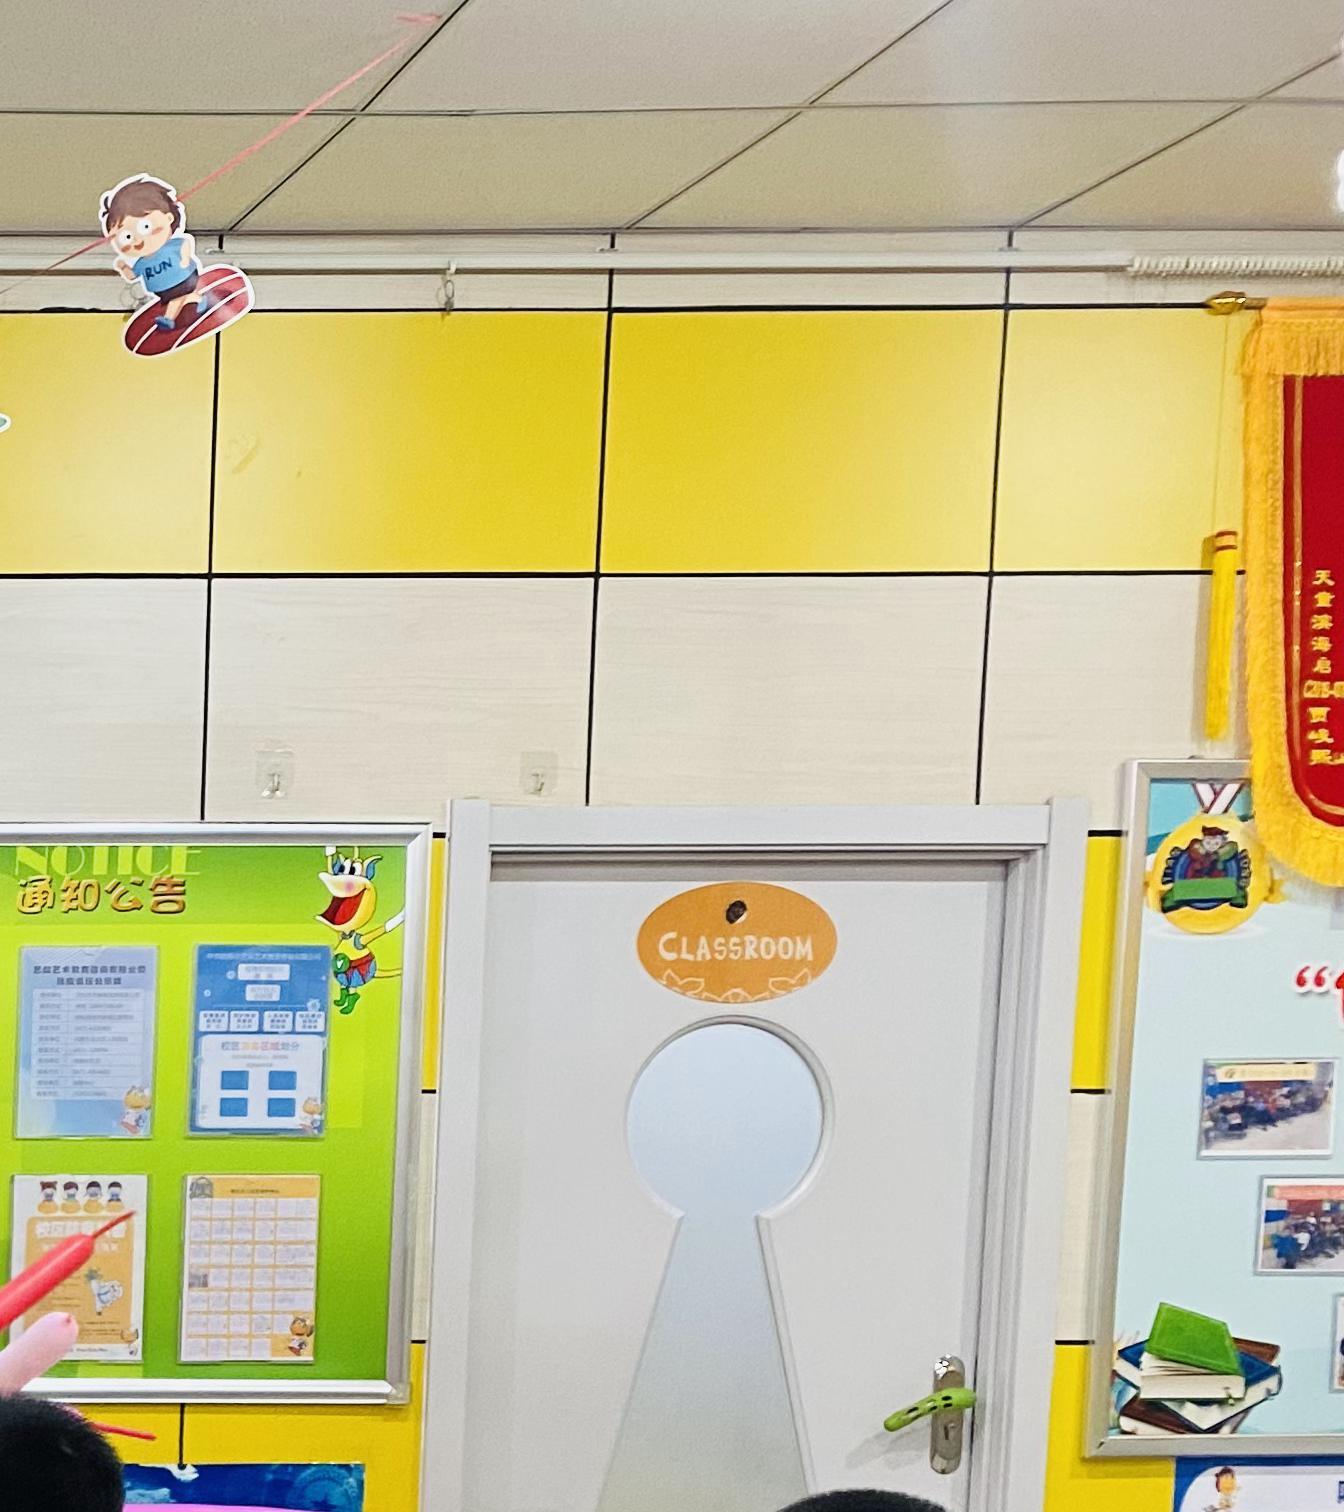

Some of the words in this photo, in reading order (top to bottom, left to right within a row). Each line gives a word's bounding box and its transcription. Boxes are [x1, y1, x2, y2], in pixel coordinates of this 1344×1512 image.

[144, 257, 173, 281] RUN
[15, 846, 201, 876] NOTICE
[17, 875, 187, 914] 通知公告
[658, 932, 814, 961] CLASSROOM
